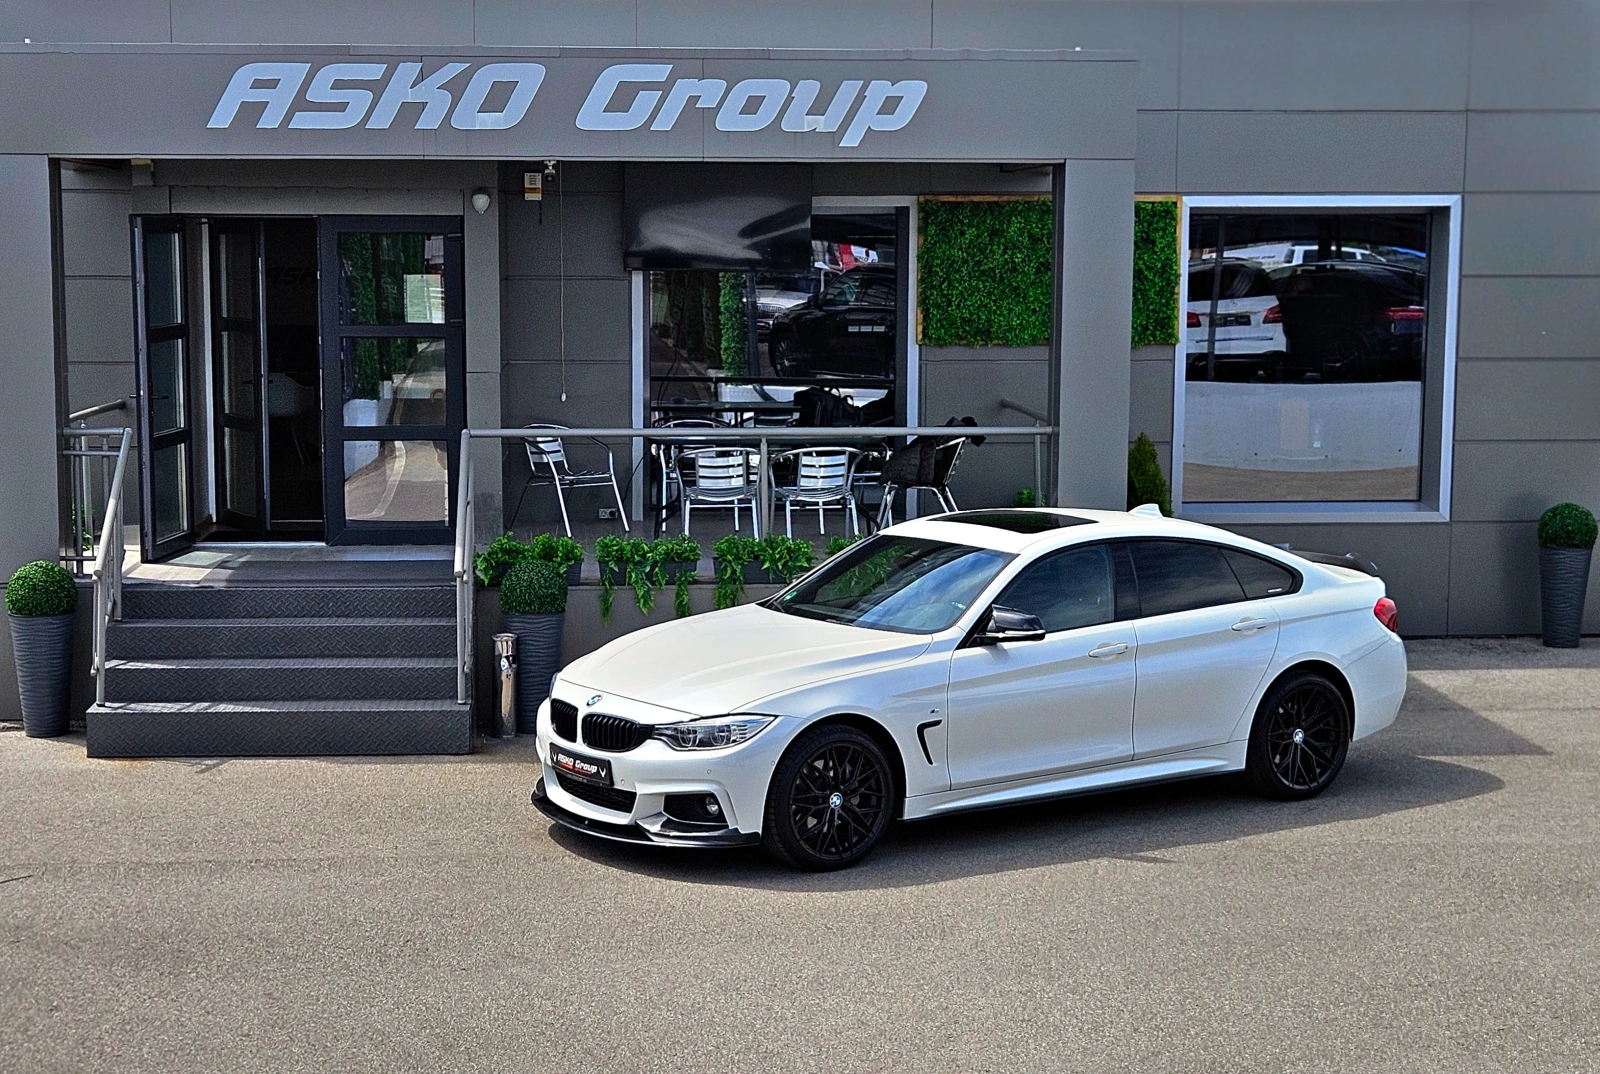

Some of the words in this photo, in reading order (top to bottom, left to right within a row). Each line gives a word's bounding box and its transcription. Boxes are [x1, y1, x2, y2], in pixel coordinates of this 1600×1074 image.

[206, 62, 546, 129] ASKO
[575, 64, 928, 146] Group
[558, 753, 574, 766] ASKO
[575, 760, 598, 773] Group
